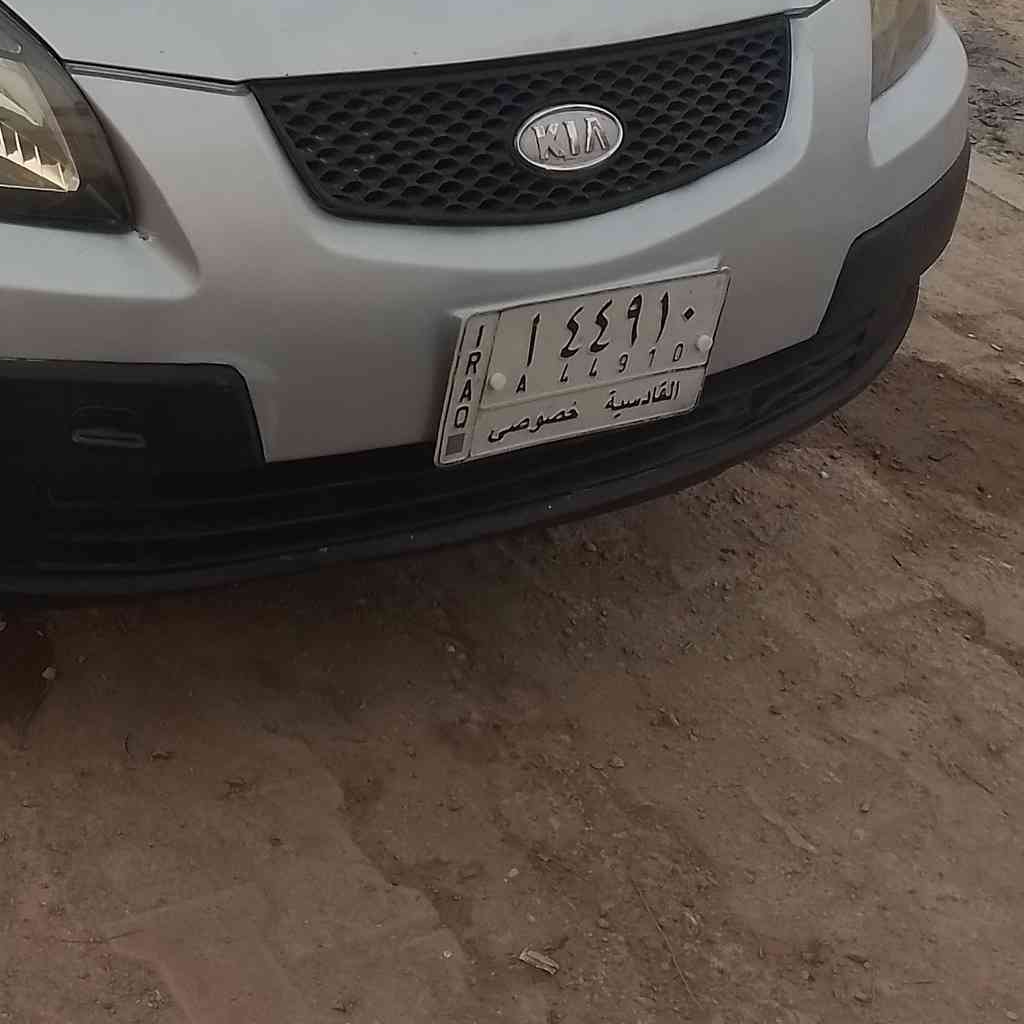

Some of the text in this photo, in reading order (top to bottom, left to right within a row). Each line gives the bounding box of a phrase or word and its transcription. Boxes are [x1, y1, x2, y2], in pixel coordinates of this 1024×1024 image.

[531, 116, 610, 161] KIA
[454, 323, 485, 430] IRAQ
[604, 379, 681, 418] القادسية
